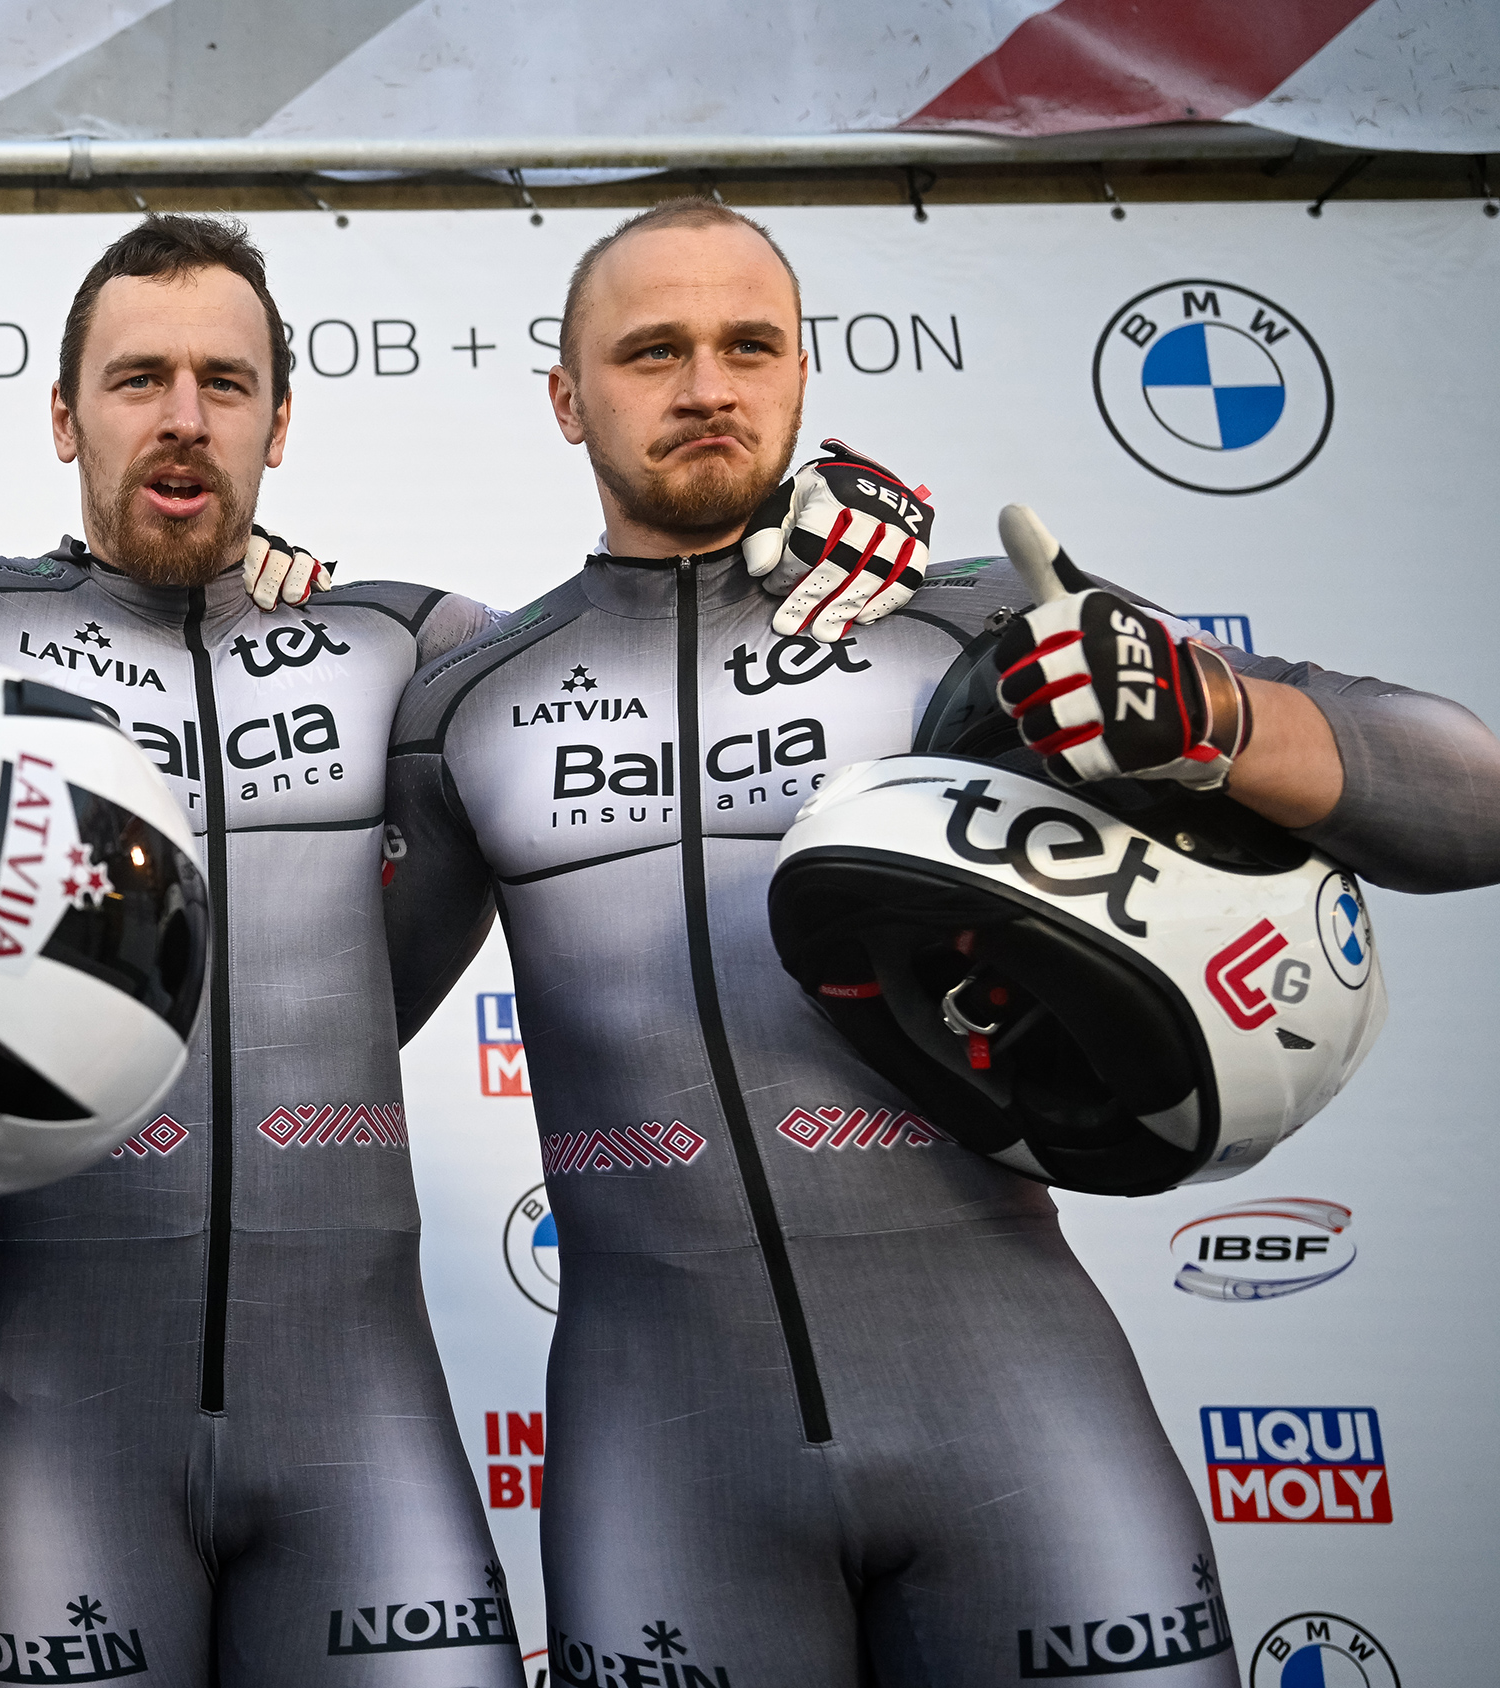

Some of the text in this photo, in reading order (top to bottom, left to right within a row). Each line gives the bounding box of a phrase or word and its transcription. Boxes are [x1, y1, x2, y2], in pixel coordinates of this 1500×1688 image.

[1120, 291, 1291, 347] BMW
[18, 630, 167, 693] LATVIJA
[229, 618, 351, 678] tet
[724, 634, 873, 696] tet
[512, 697, 649, 728] LATVIJA
[130, 703, 341, 782] alcia
[552, 717, 827, 801] Balcia
[942, 779, 1161, 938] tet
[1198, 1234, 1331, 1262] IBSF
[1208, 1409, 1377, 1465] LIQUI
[1216, 1467, 1385, 1520] MOLY
[1266, 1620, 1376, 1662] BMW
